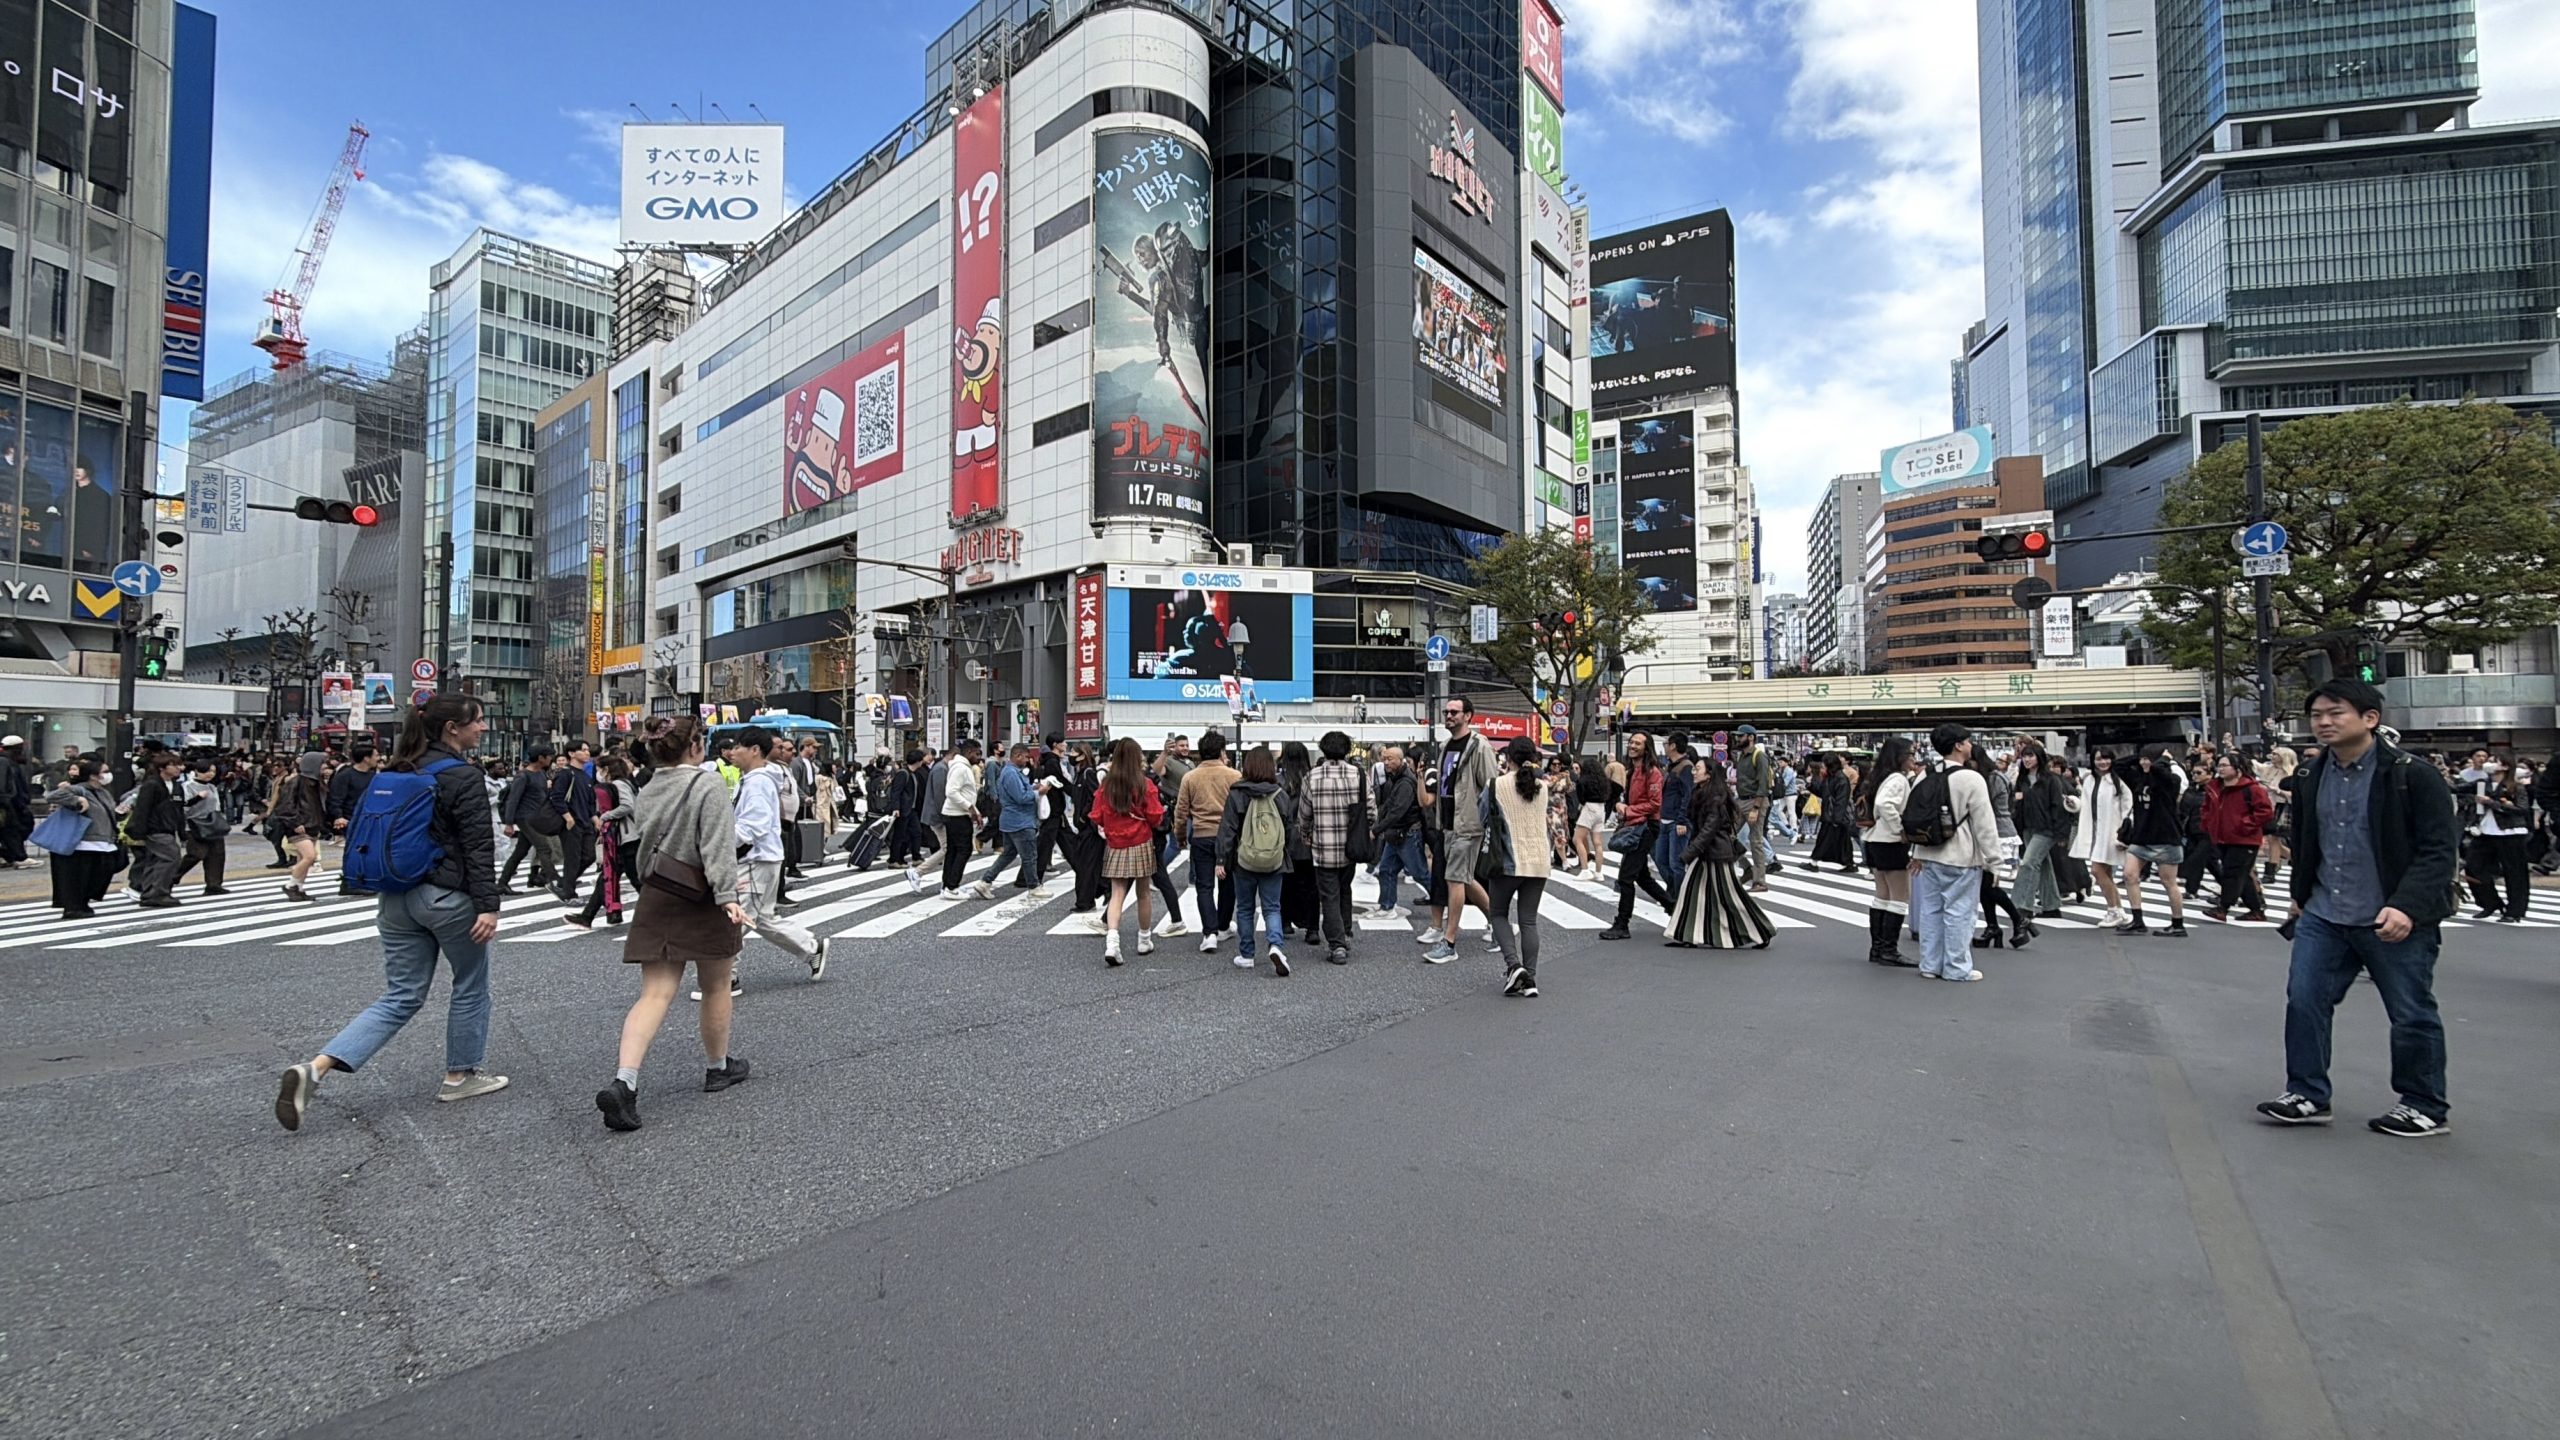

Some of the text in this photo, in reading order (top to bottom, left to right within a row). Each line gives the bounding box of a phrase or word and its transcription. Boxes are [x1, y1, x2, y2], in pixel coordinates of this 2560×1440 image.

[1528, 33, 1558, 90] アコム
[1528, 89, 1556, 171] レイク
[645, 146, 760, 164] すべての人に
[645, 169, 760, 186] インターネット
[1430, 144, 1494, 224] MAGNET
[645, 197, 759, 220] GMO
[1638, 239, 1656, 252] ON
[1677, 226, 1711, 242] PS5
[162, 266, 203, 376] SEIBU
[1576, 415, 1585, 442] レイク
[1133, 460, 1201, 480] バッドランド
[1906, 448, 1963, 472] TOSEI
[201, 472, 219, 530] 渋谷駅前
[229, 477, 242, 532] スクランブル式
[1128, 483, 1155, 505] 11.7
[1156, 491, 1173, 507] FRI
[940, 527, 1022, 580] MAGNET
[0, 579, 51, 604] YA
[1079, 582, 1098, 595] 名物
[1702, 582, 1726, 590] DARTS
[593, 612, 601, 643] TOUCH
[1367, 627, 1402, 637] COFFEE
[2045, 614, 2070, 625] 楽待
[1079, 596, 1097, 688] 天津甘栗
[1807, 683, 1830, 698] JR
